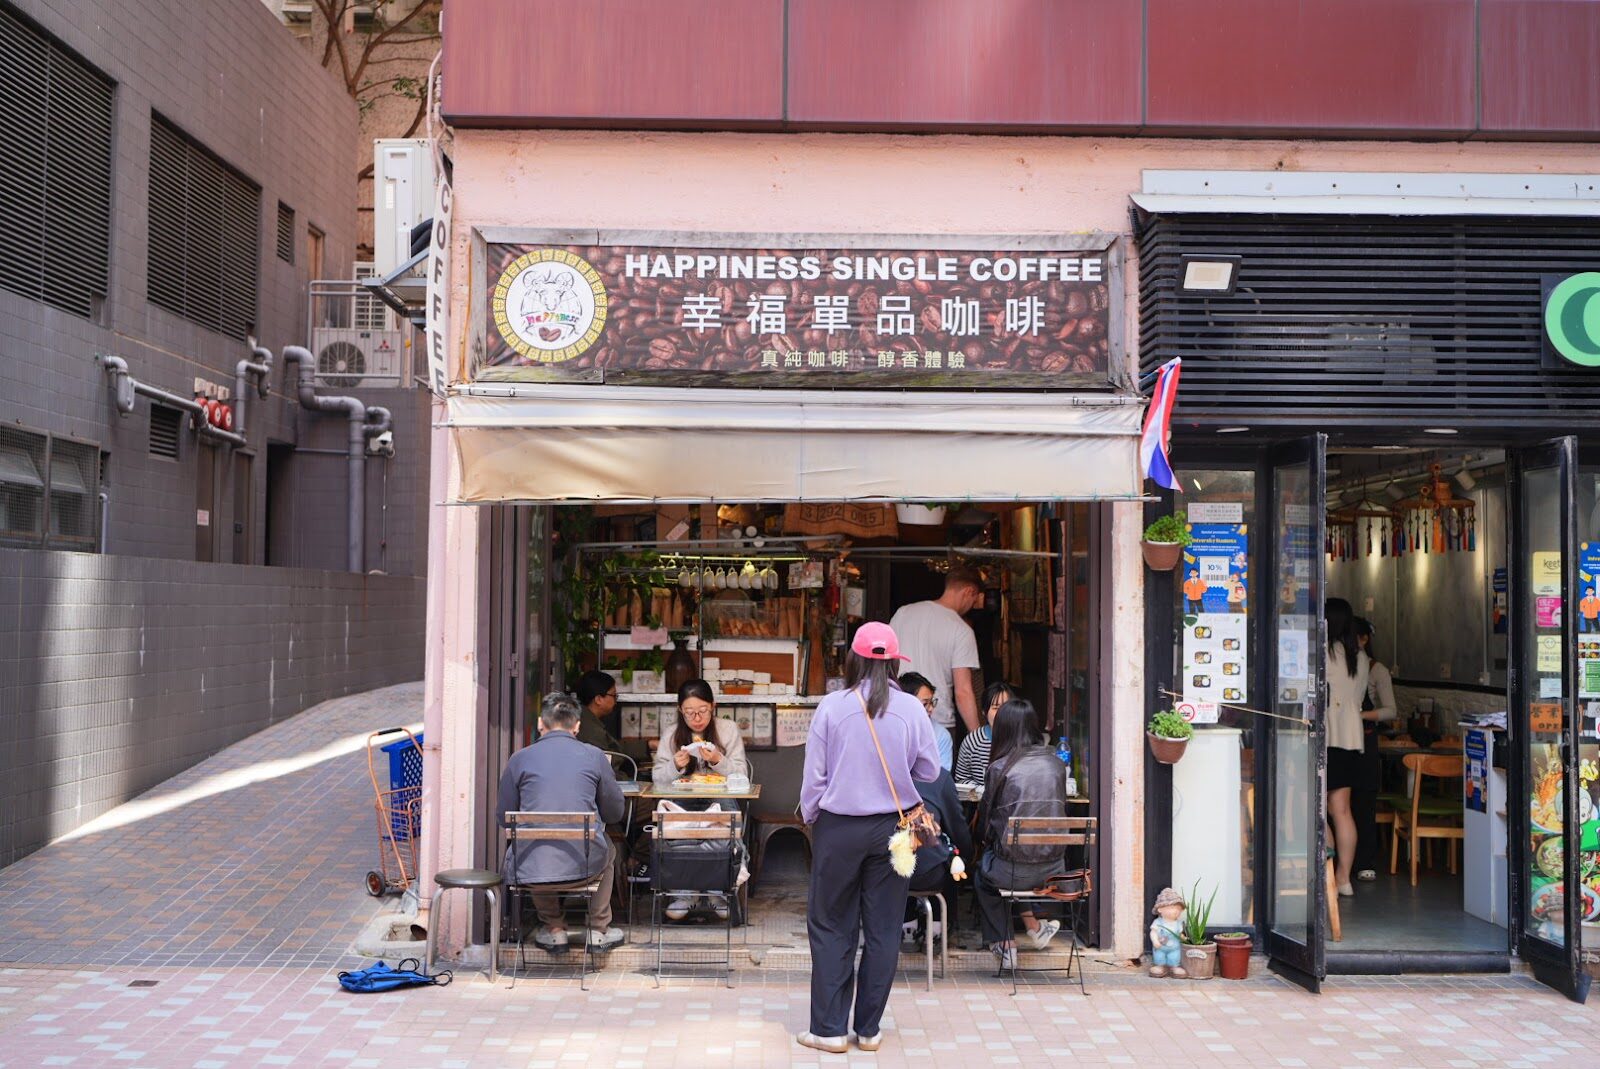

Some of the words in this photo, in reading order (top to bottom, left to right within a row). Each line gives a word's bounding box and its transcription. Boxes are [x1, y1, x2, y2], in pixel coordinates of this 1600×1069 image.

[625, 254, 821, 280] HAPPINESS
[832, 256, 958, 281] SINGLE
[969, 257, 1102, 282] COFFEE
[433, 184, 450, 397] COFFEE
[682, 293, 1046, 337] 幸福單品咖啡
